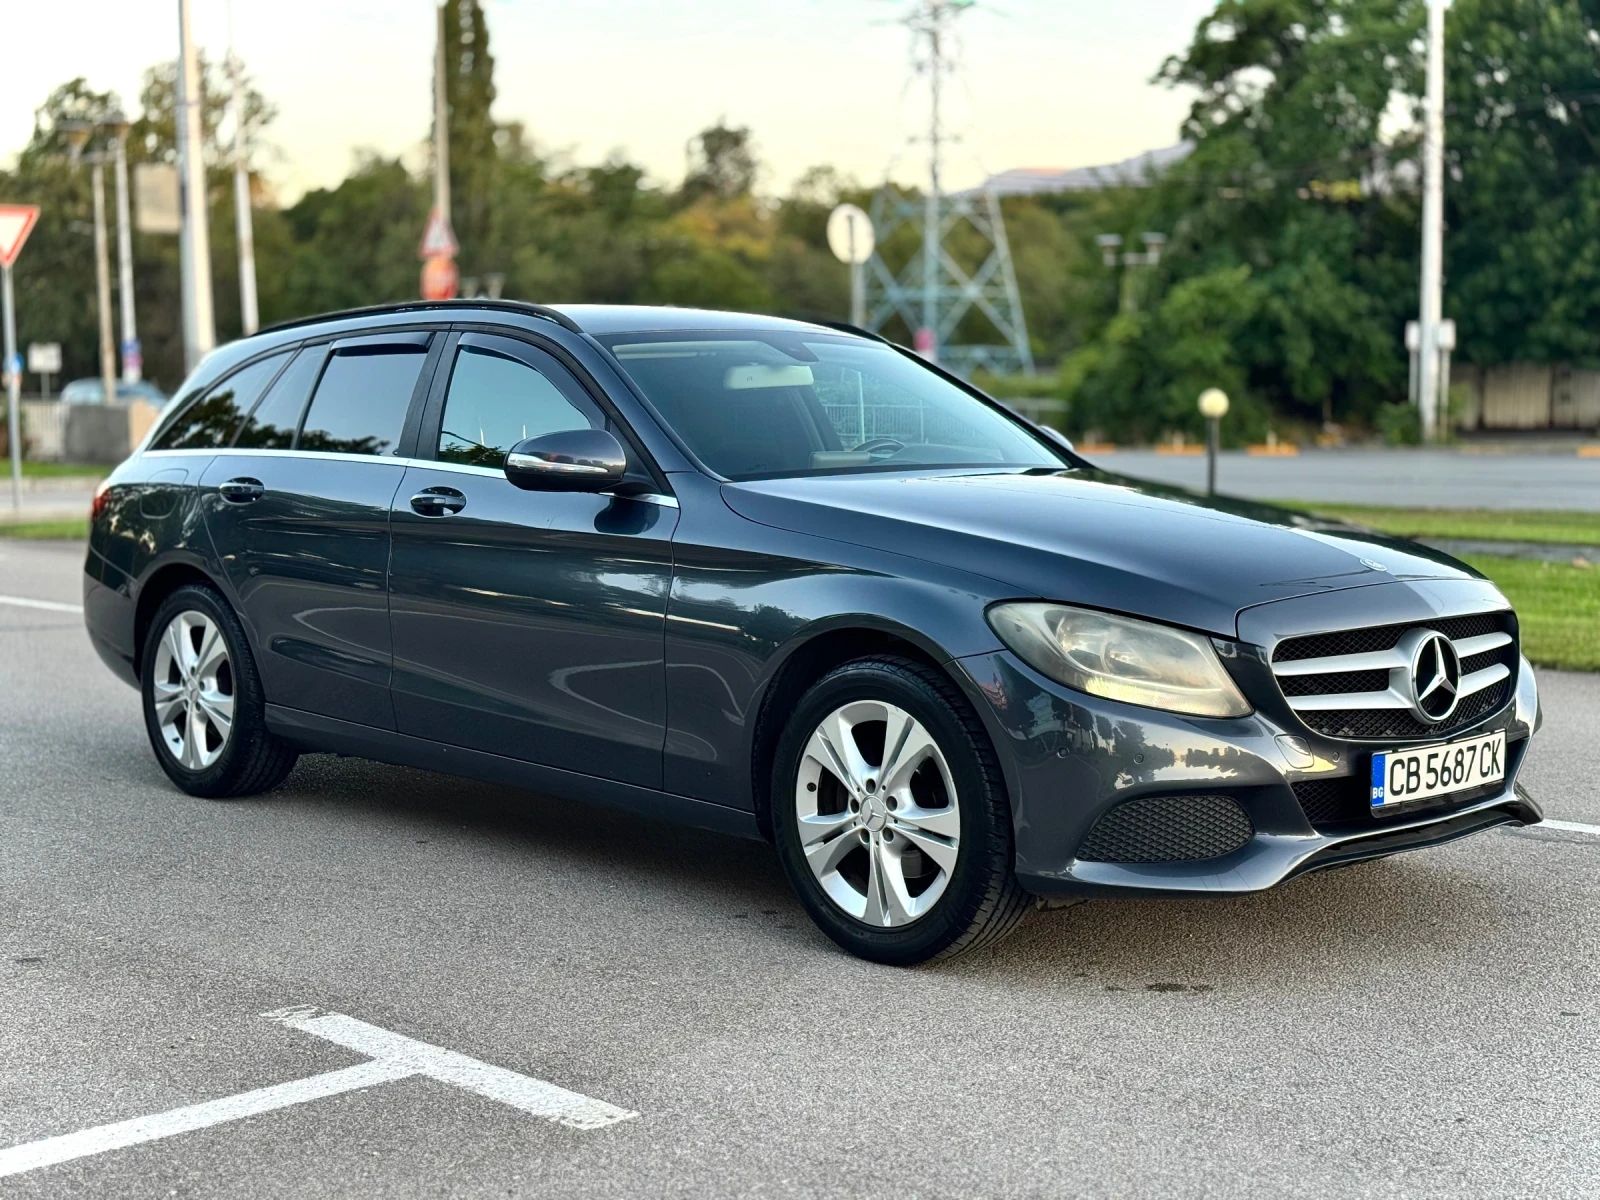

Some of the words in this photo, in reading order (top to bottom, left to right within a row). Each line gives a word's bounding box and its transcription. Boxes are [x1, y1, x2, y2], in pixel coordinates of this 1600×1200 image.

[1389, 756, 1420, 796] CB
[1426, 745, 1477, 790] 5687
[1479, 738, 1502, 778] CK
[1372, 787, 1384, 799] BG
